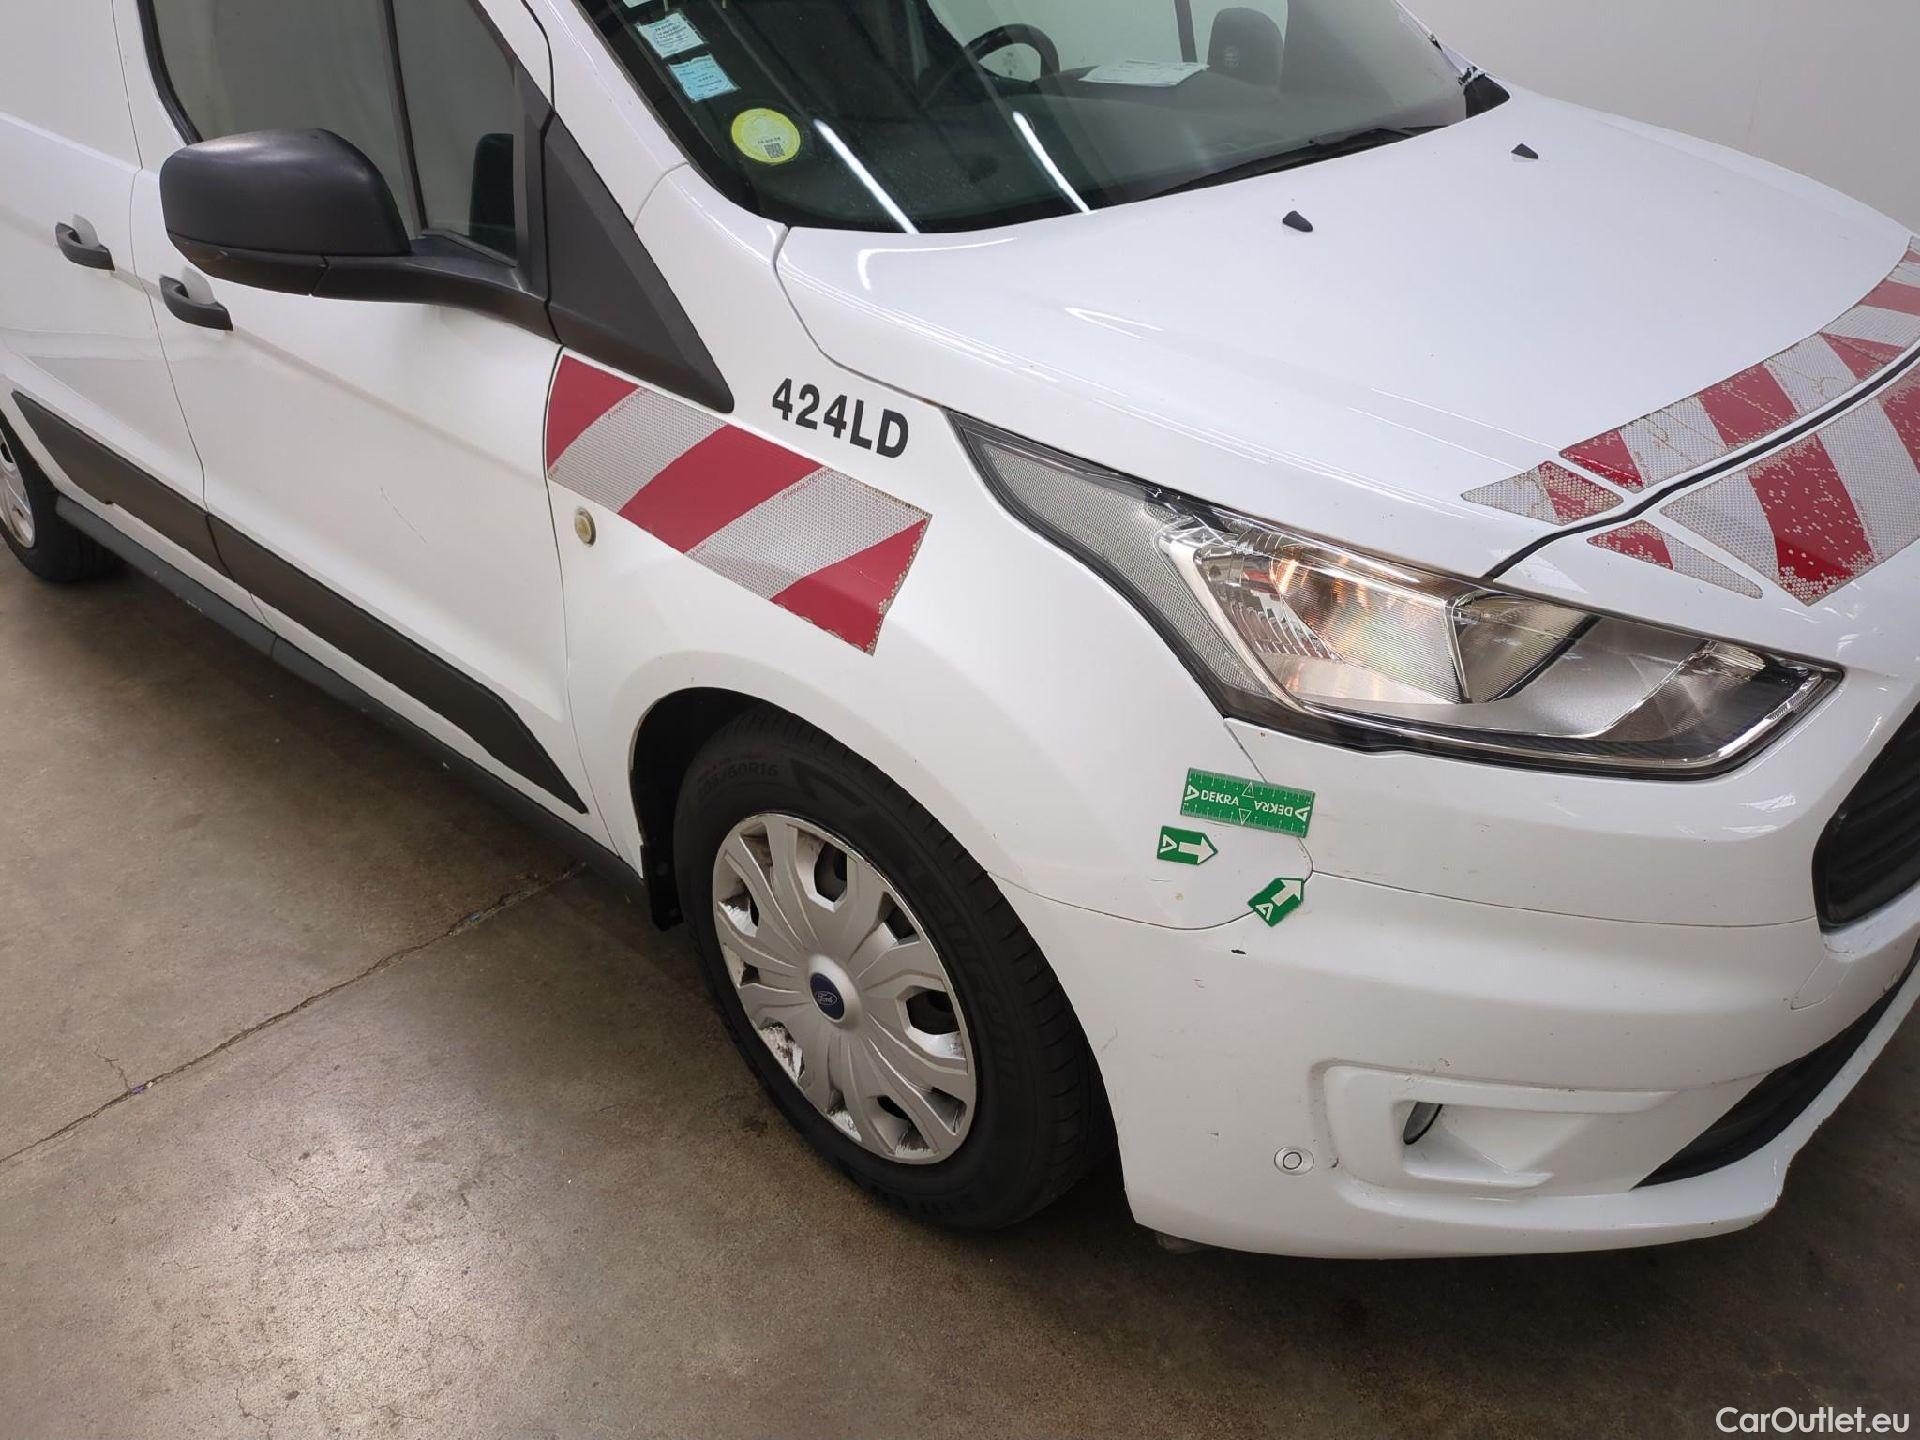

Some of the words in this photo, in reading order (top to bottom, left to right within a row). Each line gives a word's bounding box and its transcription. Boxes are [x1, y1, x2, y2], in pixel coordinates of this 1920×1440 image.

[772, 378, 909, 459] 424LD
[1201, 789, 1240, 806] DEKRA
[1253, 800, 1293, 817] DEKRA
